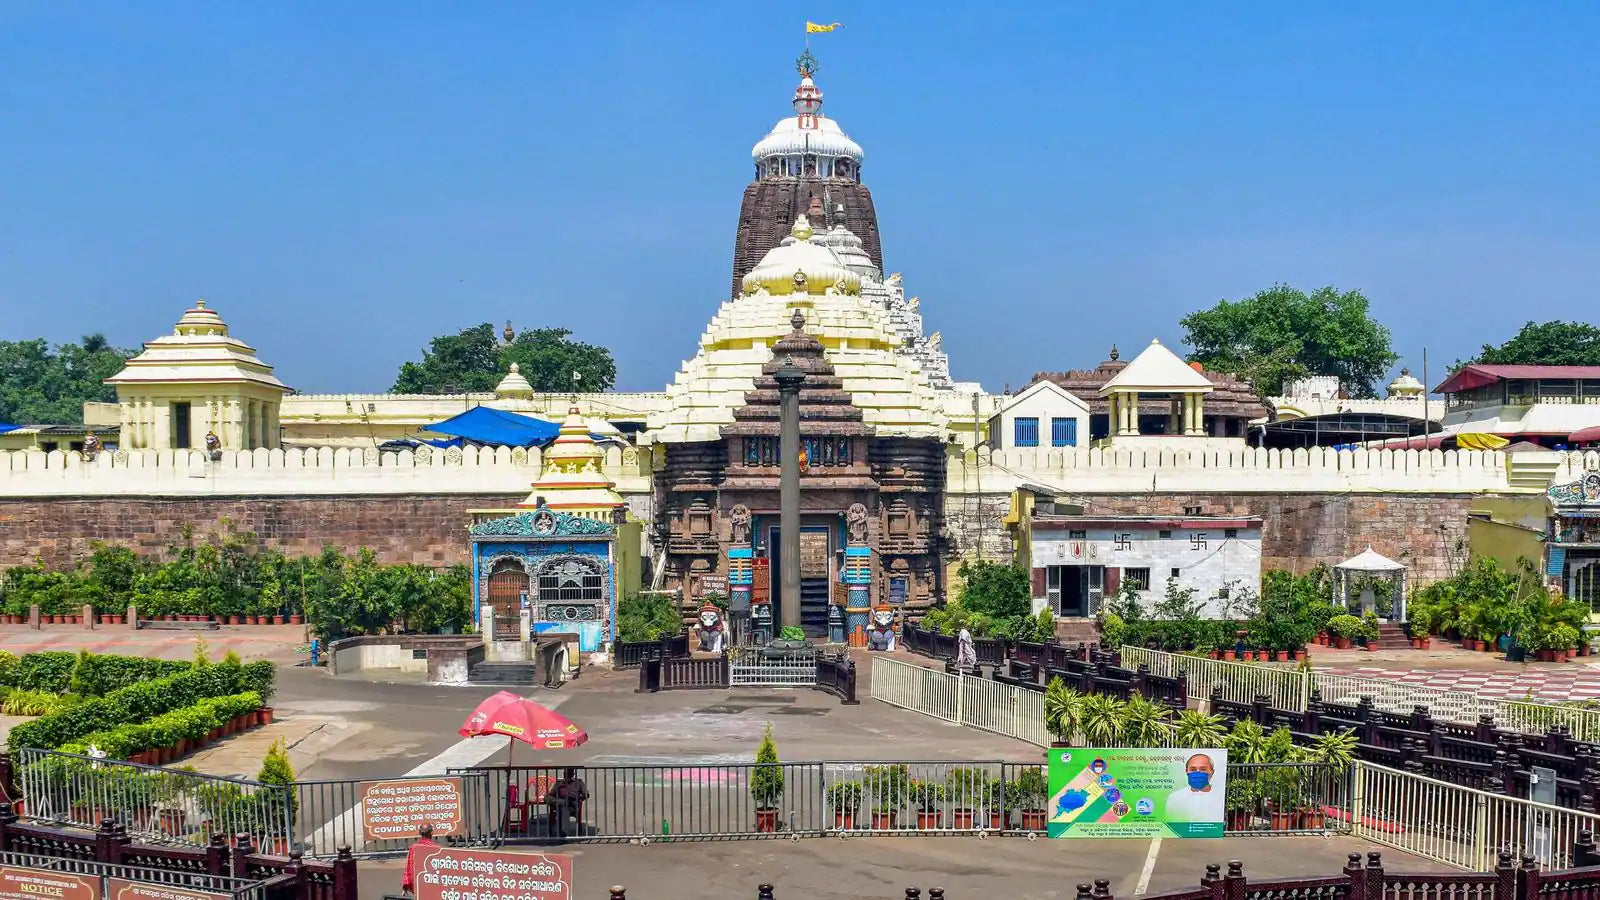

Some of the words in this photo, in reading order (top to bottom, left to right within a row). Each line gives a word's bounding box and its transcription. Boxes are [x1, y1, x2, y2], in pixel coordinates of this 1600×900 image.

[431, 856, 458, 870] ଶ୍ରୀମନ୍ଦିର
[461, 858, 494, 874] ପରିସରକୁ
[496, 860, 530, 874] ବିଶୋଧନ
[532, 862, 555, 876] କରିବା
[20, 883, 63, 895] NOTICE
[424, 870, 440, 884] ପାଇଁ
[441, 875, 469, 886] ପ୍ରତ୍ୟେକ
[472, 874, 500, 889] ରବିବାର
[503, 875, 516, 889] ଦିନ
[518, 877, 562, 892] ସର୍ବସାଧାରଣ
